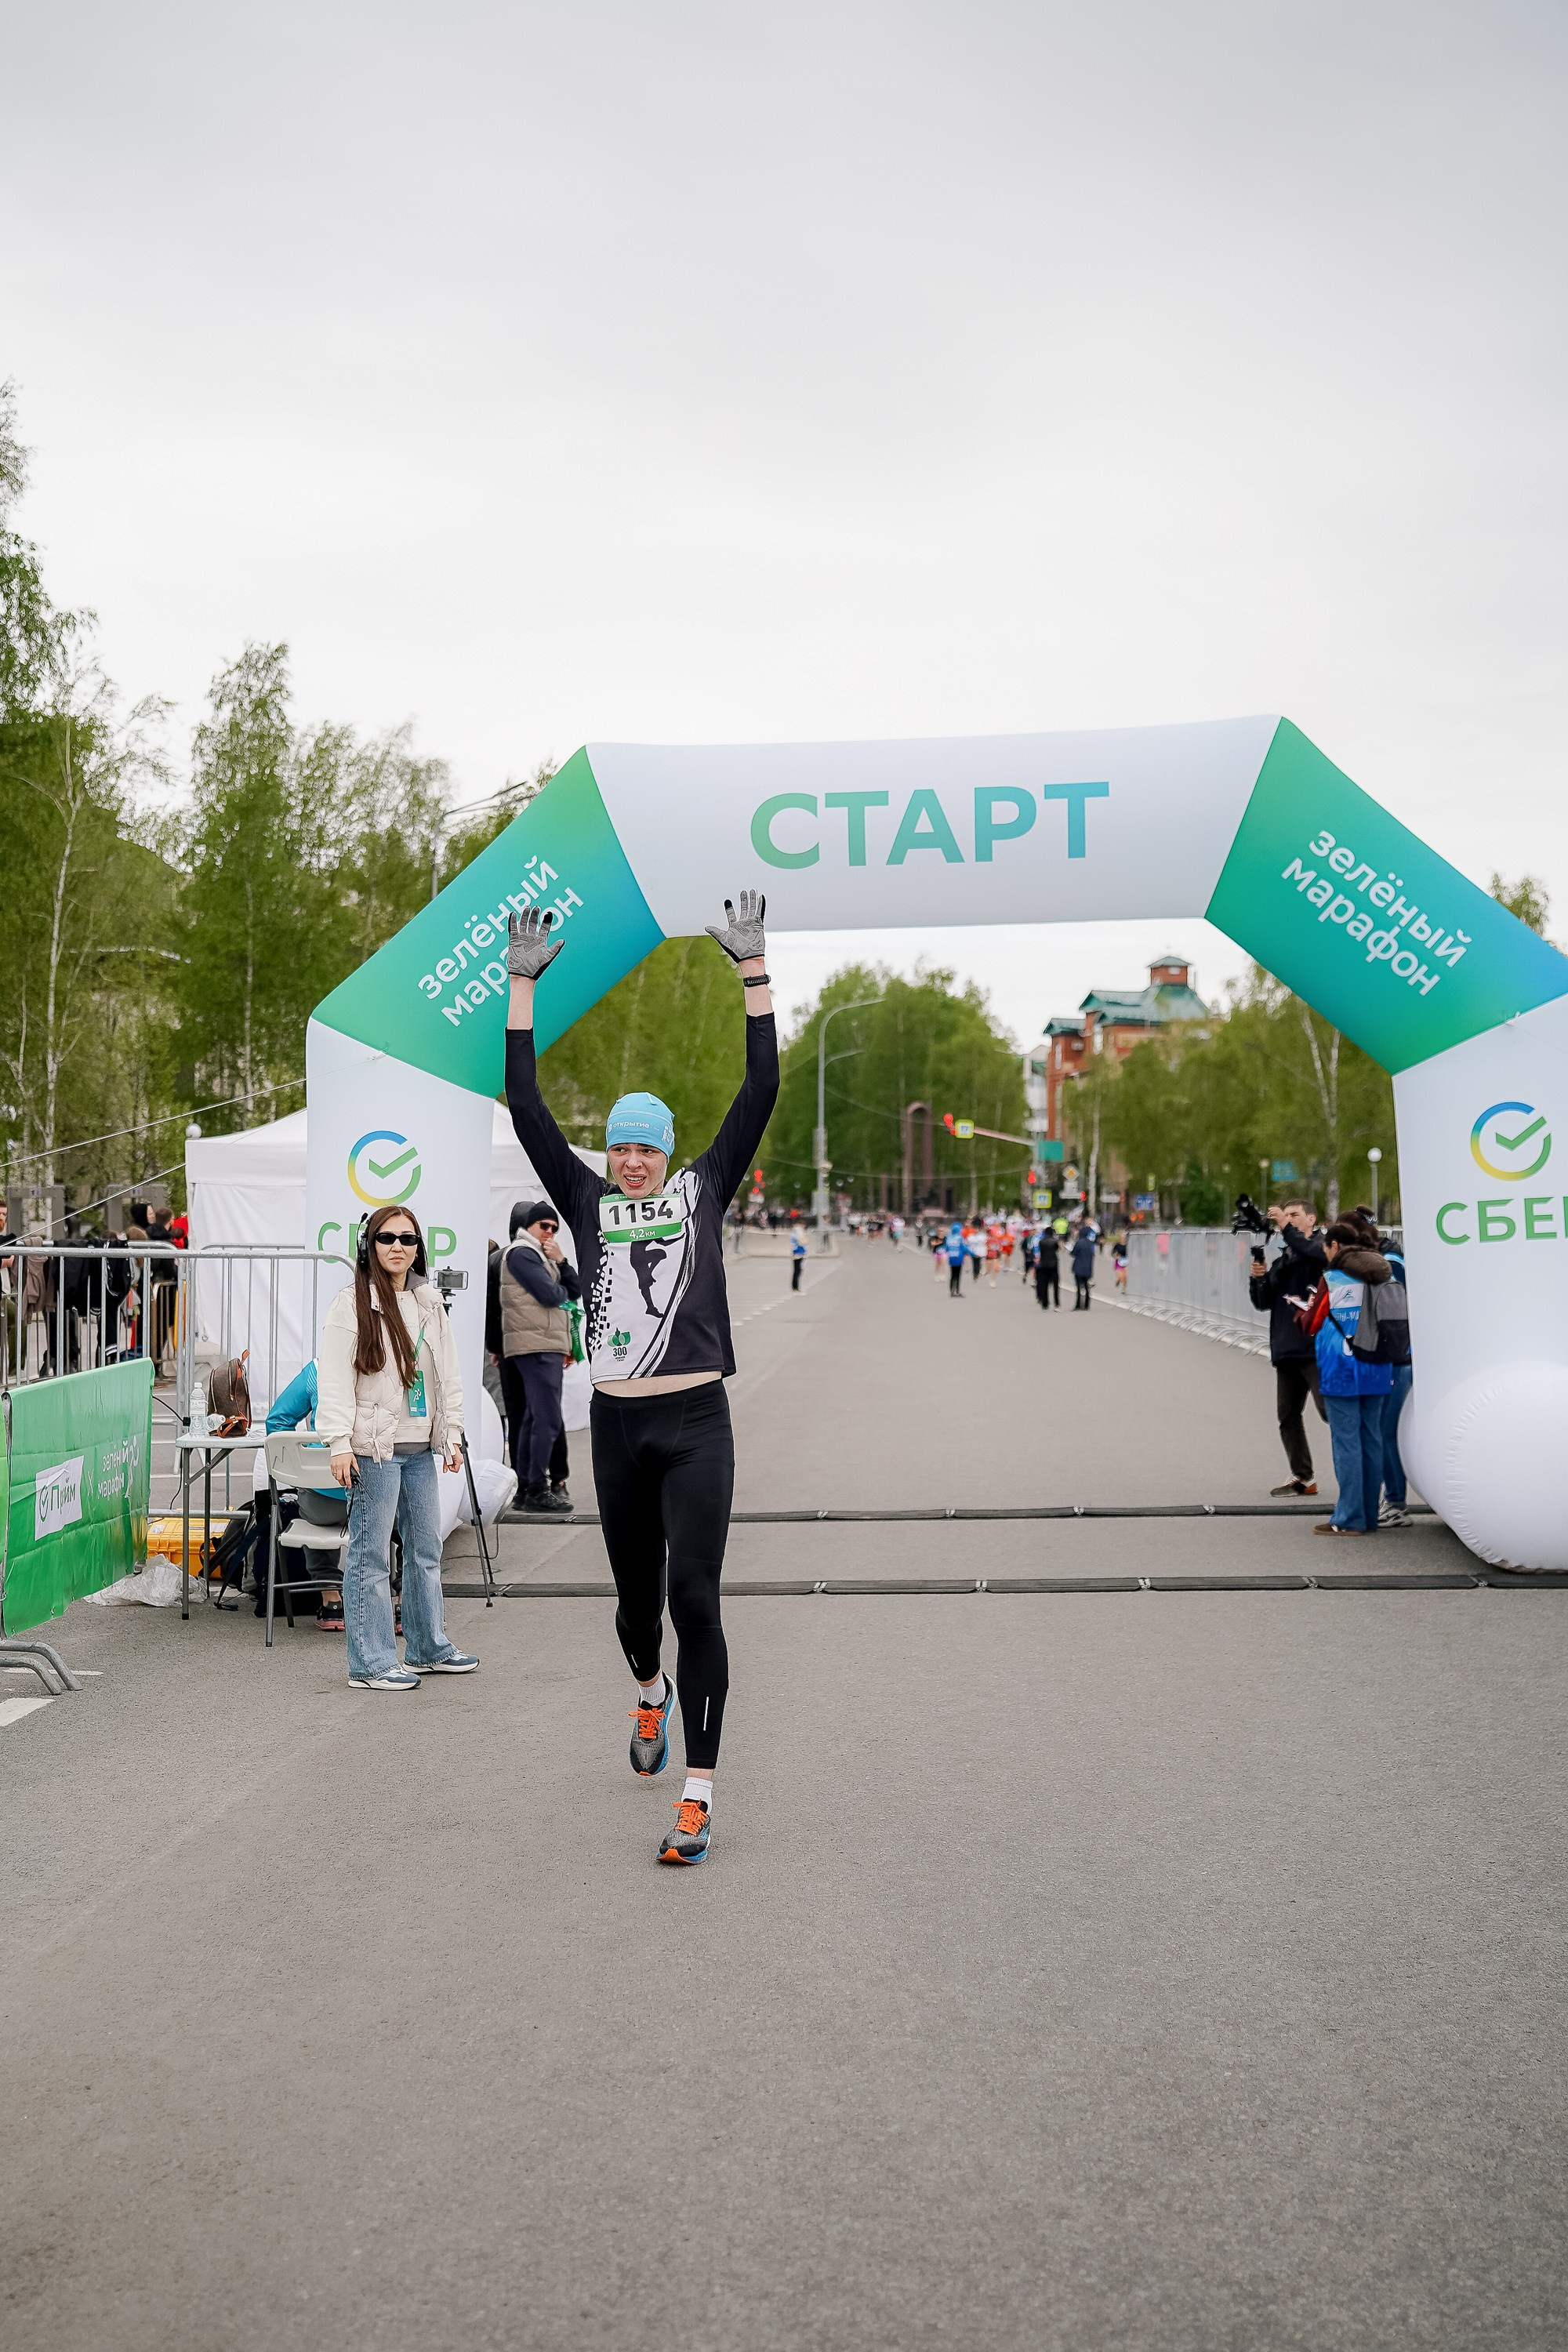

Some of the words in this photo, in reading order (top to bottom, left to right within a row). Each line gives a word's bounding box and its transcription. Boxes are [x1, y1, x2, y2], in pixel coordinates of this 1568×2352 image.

[750, 781, 1109, 870] СТАРТ
[417, 855, 559, 1000] зелёный
[1280, 857, 1441, 996] марафон
[1308, 829, 1473, 968] зелёный
[440, 887, 584, 1027] марон
[318, 1221, 457, 1269] СР
[608, 1200, 673, 1225] 1154
[1436, 1196, 1568, 1246] СБЕ
[612, 1346, 627, 1357] 300
